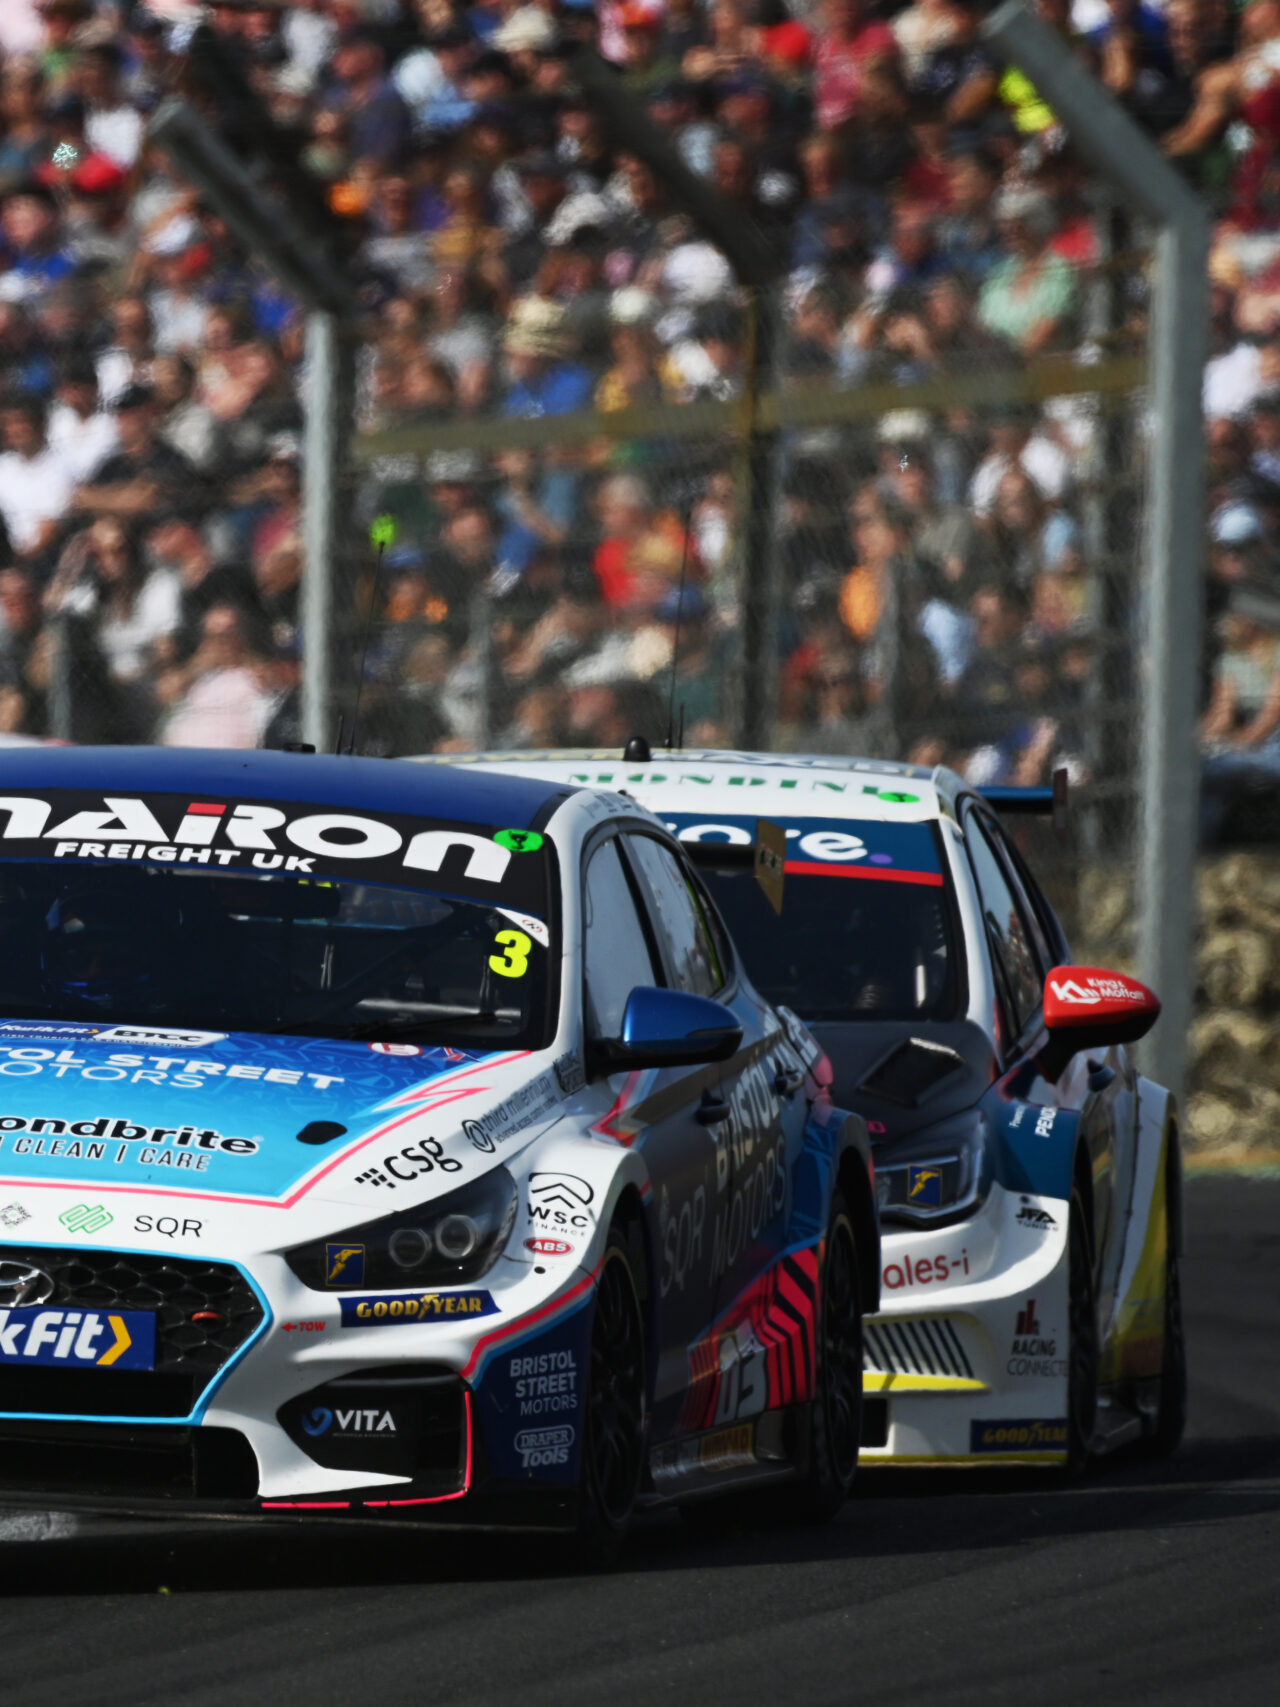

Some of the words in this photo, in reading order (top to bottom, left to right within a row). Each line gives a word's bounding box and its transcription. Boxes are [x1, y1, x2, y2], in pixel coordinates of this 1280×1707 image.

[53, 841, 241, 866] FREIGHT
[251, 852, 317, 873] UK
[488, 929, 532, 978] 3
[114, 1029, 204, 1043] BTCC
[104, 1053, 346, 1090] STREET
[15, 1137, 107, 1162] CLEAN
[139, 1147, 214, 1173] CARE
[383, 1136, 463, 1181] csg
[133, 1214, 204, 1239] SQR
[527, 1202, 589, 1229] WSC
[531, 1239, 568, 1253] ABS
[356, 1294, 483, 1320] GOODYEAR
[299, 1321, 327, 1332] TOW
[1011, 1339, 1057, 1358] RACING
[509, 1349, 577, 1378] BRISTOL
[515, 1371, 577, 1398] STREET
[520, 1393, 578, 1416] MOTORS
[335, 1409, 397, 1432] VITA
[520, 1429, 570, 1448] DRAPER
[521, 1446, 569, 1468] Tools
